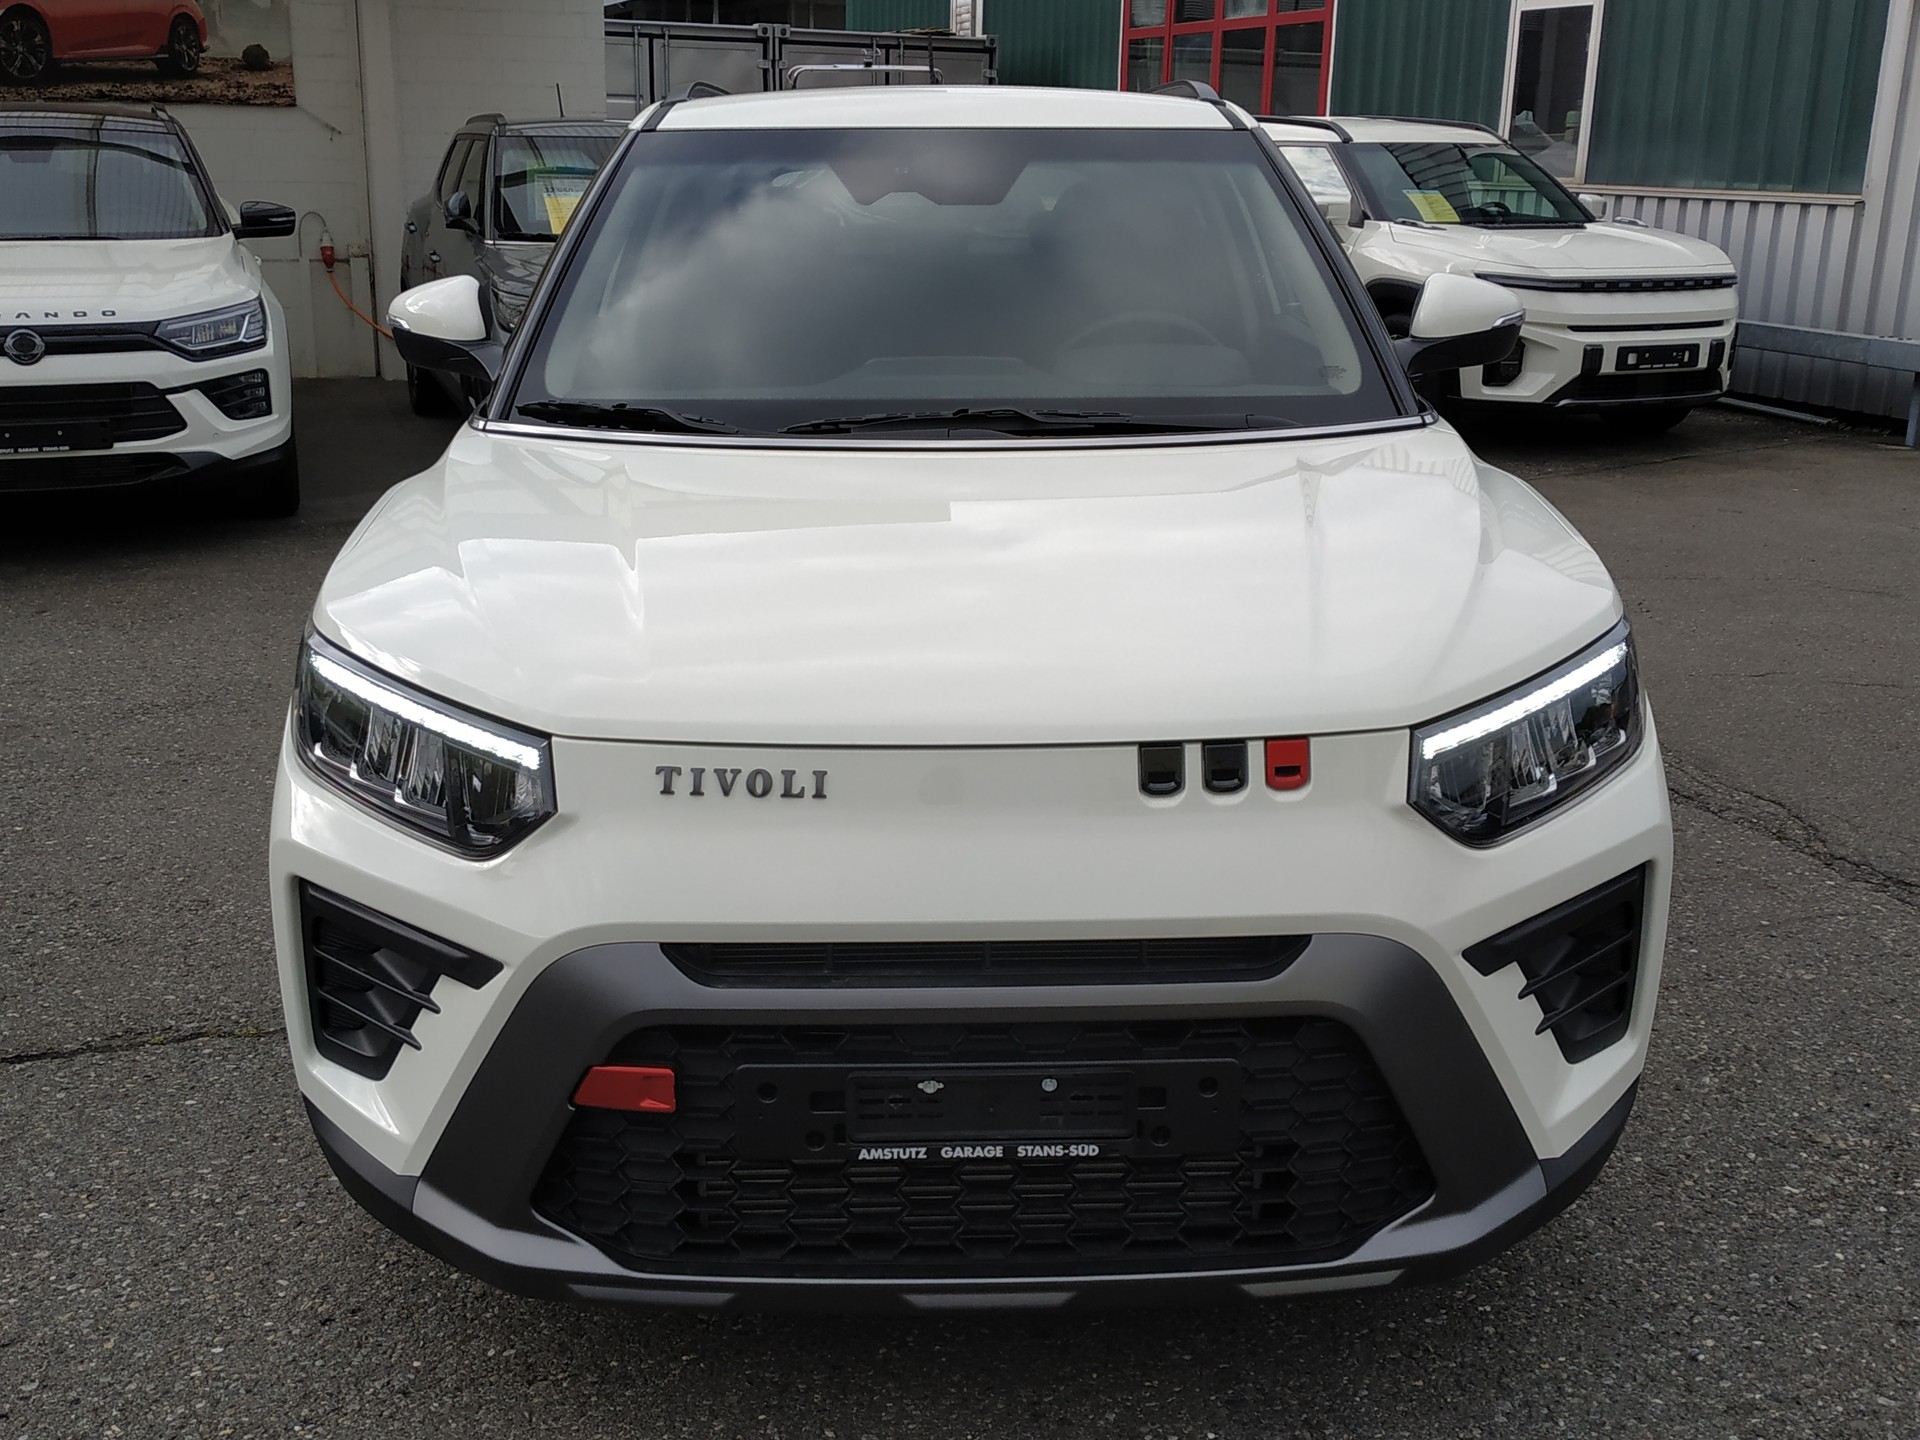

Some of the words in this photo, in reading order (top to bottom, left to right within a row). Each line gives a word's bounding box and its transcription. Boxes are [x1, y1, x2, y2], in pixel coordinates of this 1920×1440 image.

[0, 310, 116, 319] ANDO
[655, 766, 828, 799] TIVOLI
[858, 1148, 927, 1160] AMSTUTZ
[940, 1146, 1004, 1158] GARAGE
[1017, 1144, 1100, 1157] STANS-SÜD
